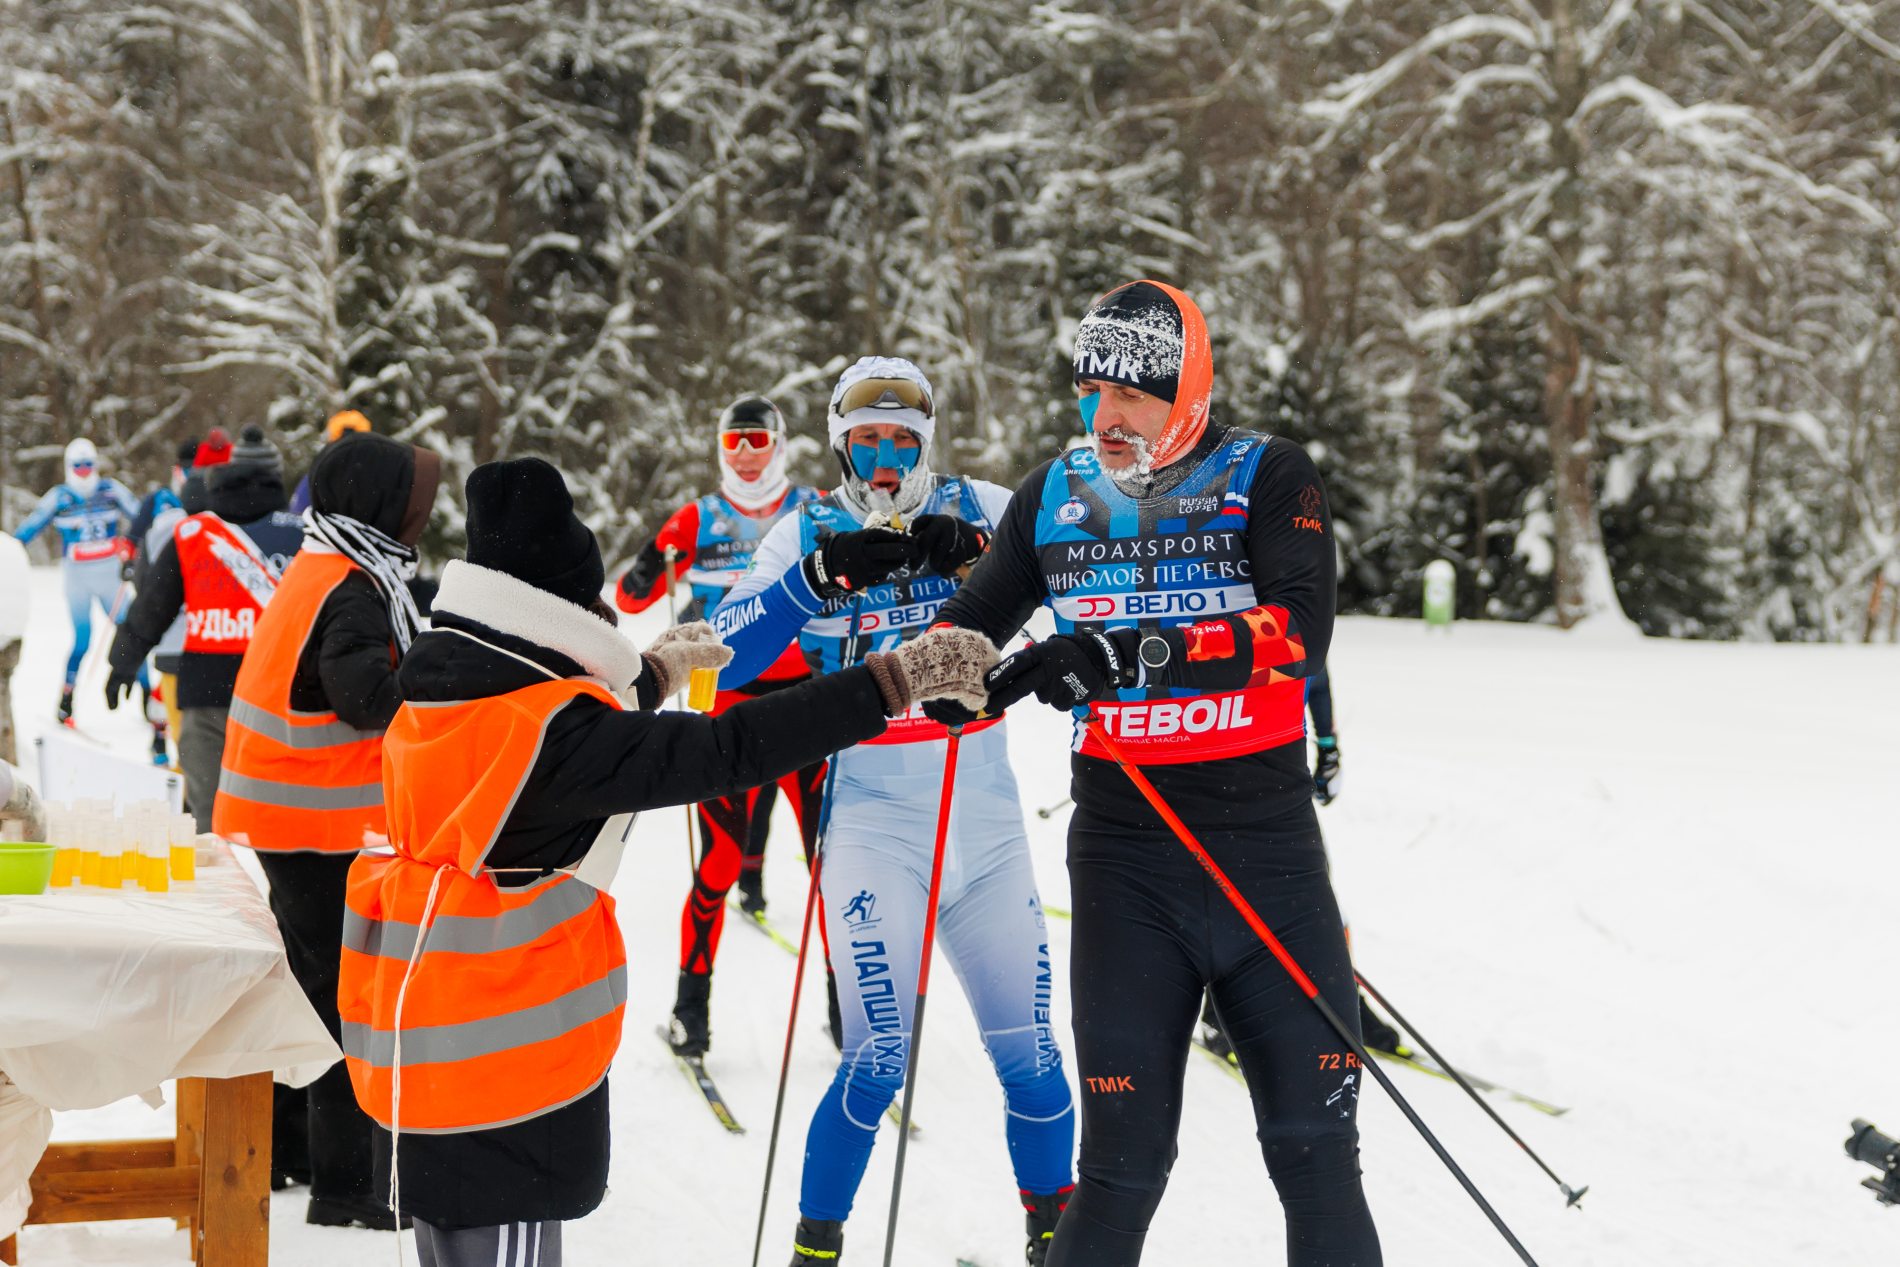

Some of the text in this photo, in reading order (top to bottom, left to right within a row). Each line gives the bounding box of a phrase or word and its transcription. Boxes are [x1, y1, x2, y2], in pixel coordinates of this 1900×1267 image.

[1179, 496, 1219, 507] RUSSIA
[1067, 533, 1234, 562] MOAXSPORT
[818, 586, 904, 614] ИКОЛОВ
[1125, 590, 1227, 615] ВЕЛО 1
[1093, 633, 1120, 671] ATOMIC
[1097, 695, 1253, 738] TEBOIL
[1153, 735, 1191, 744] МАСЛА
[851, 940, 904, 1077] ЛАПШИХА
[1318, 1053, 1341, 1070] 72
